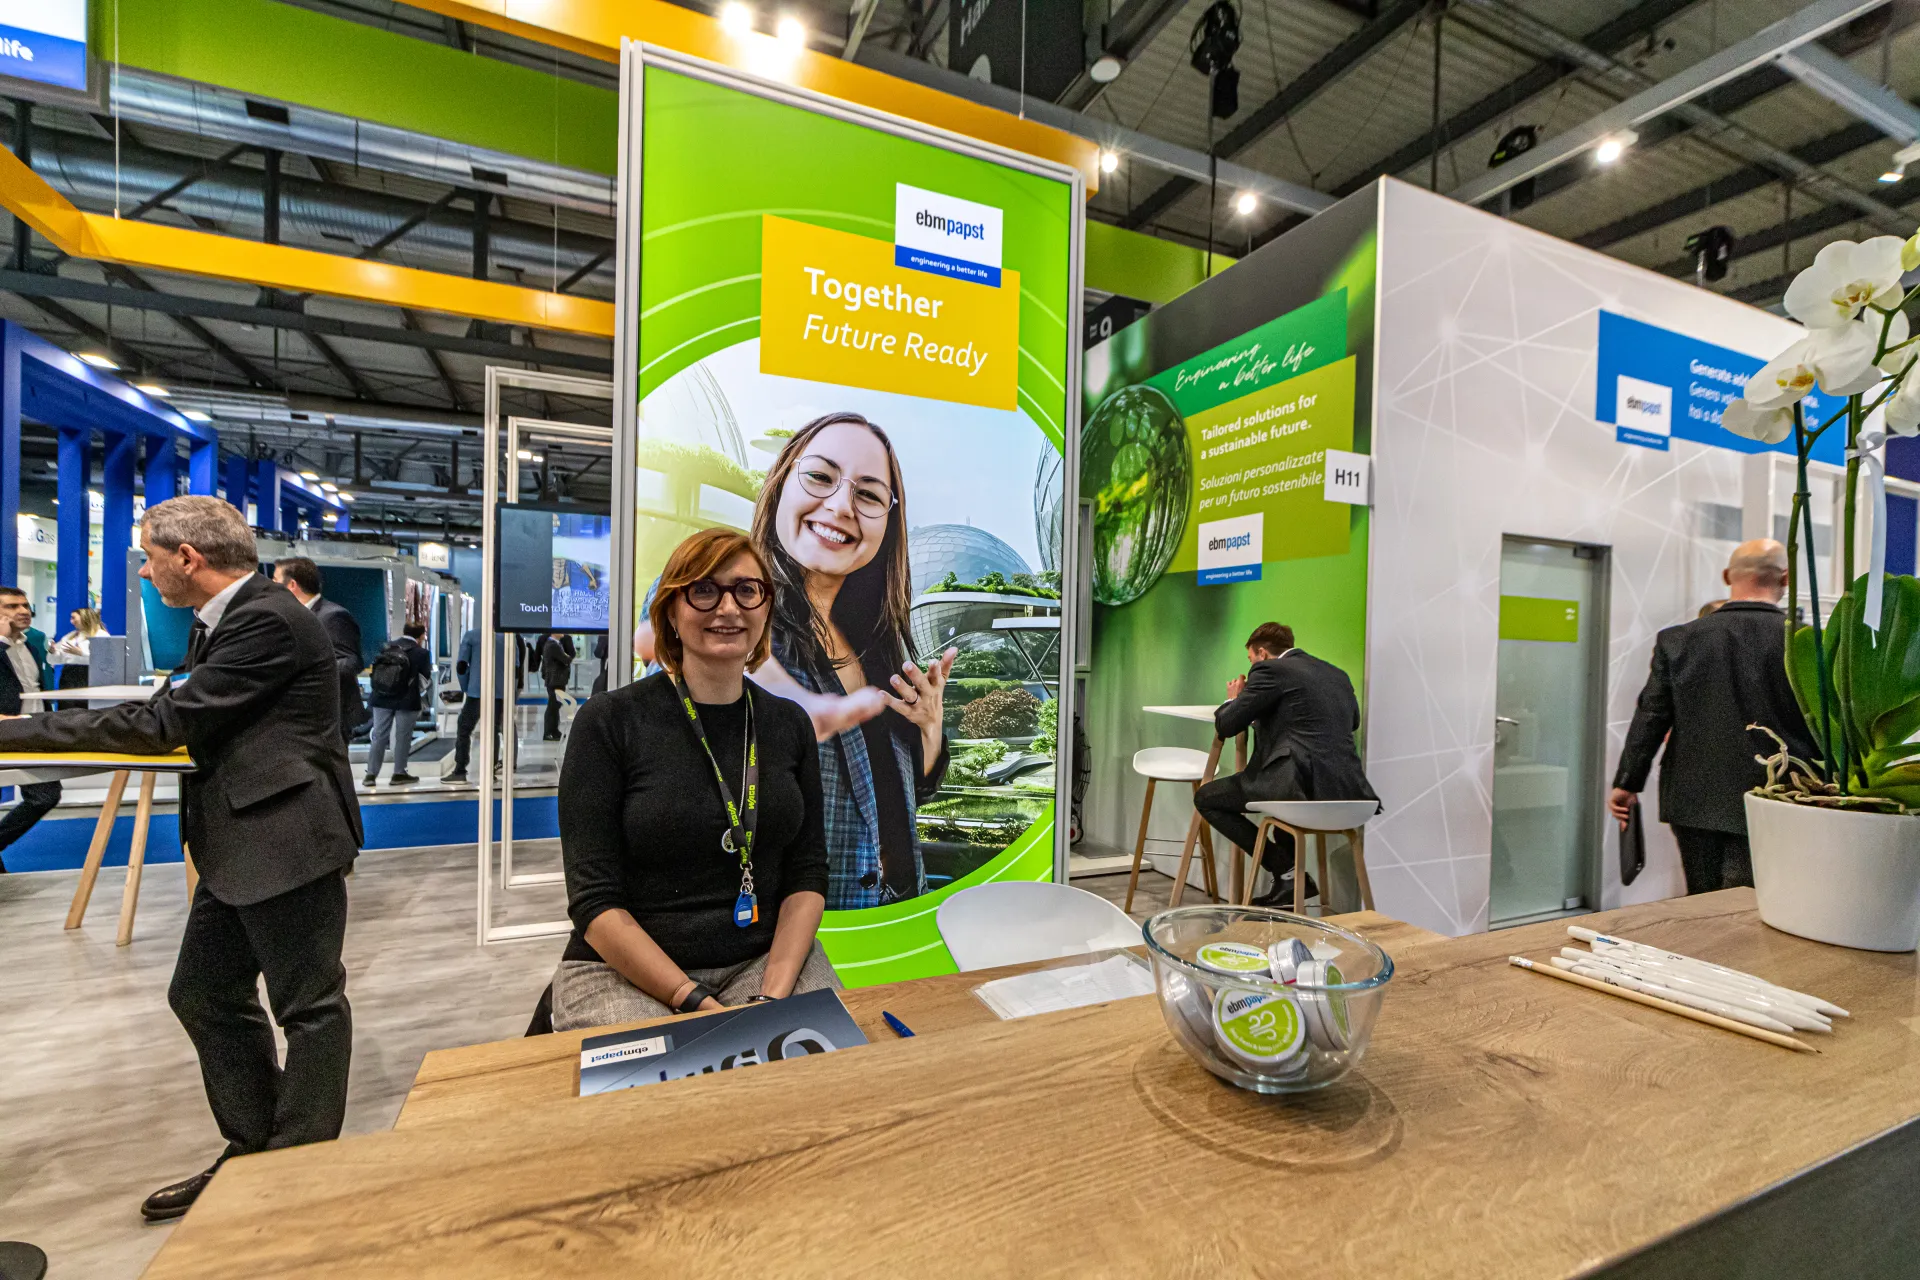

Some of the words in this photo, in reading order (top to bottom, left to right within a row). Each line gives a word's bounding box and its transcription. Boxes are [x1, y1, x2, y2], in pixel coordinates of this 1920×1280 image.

[916, 209, 985, 240] ebmpapst
[910, 256, 950, 272] engineering
[956, 265, 977, 277] better
[977, 269, 988, 279] life
[803, 266, 943, 319] Together
[803, 313, 897, 355] Future
[904, 332, 988, 377] Ready
[1175, 343, 1261, 392] Engineering
[1218, 381, 1230, 391] a
[1233, 354, 1277, 386] better
[1281, 341, 1315, 372] life
[1201, 417, 1242, 441] Tailored
[1243, 402, 1296, 428] solutions
[1298, 394, 1318, 410] for
[1200, 450, 1207, 460] a
[1208, 430, 1268, 458] sustainable
[1270, 419, 1312, 440] future.
[1200, 469, 1243, 491] Soluzioni
[1243, 450, 1324, 484] personalizzate
[1335, 468, 1360, 488] H11
[1198, 497, 1213, 512] per
[1215, 495, 1227, 505] un
[1227, 486, 1261, 507] futuro
[1262, 470, 1325, 496] sostenibile.
[1208, 531, 1251, 551] ebmpapst
[520, 602, 549, 613] Touch
[727, 801, 740, 827] WAGO
[748, 785, 757, 810] WAGO
[590, 1046, 649, 1063] ebmpapst
